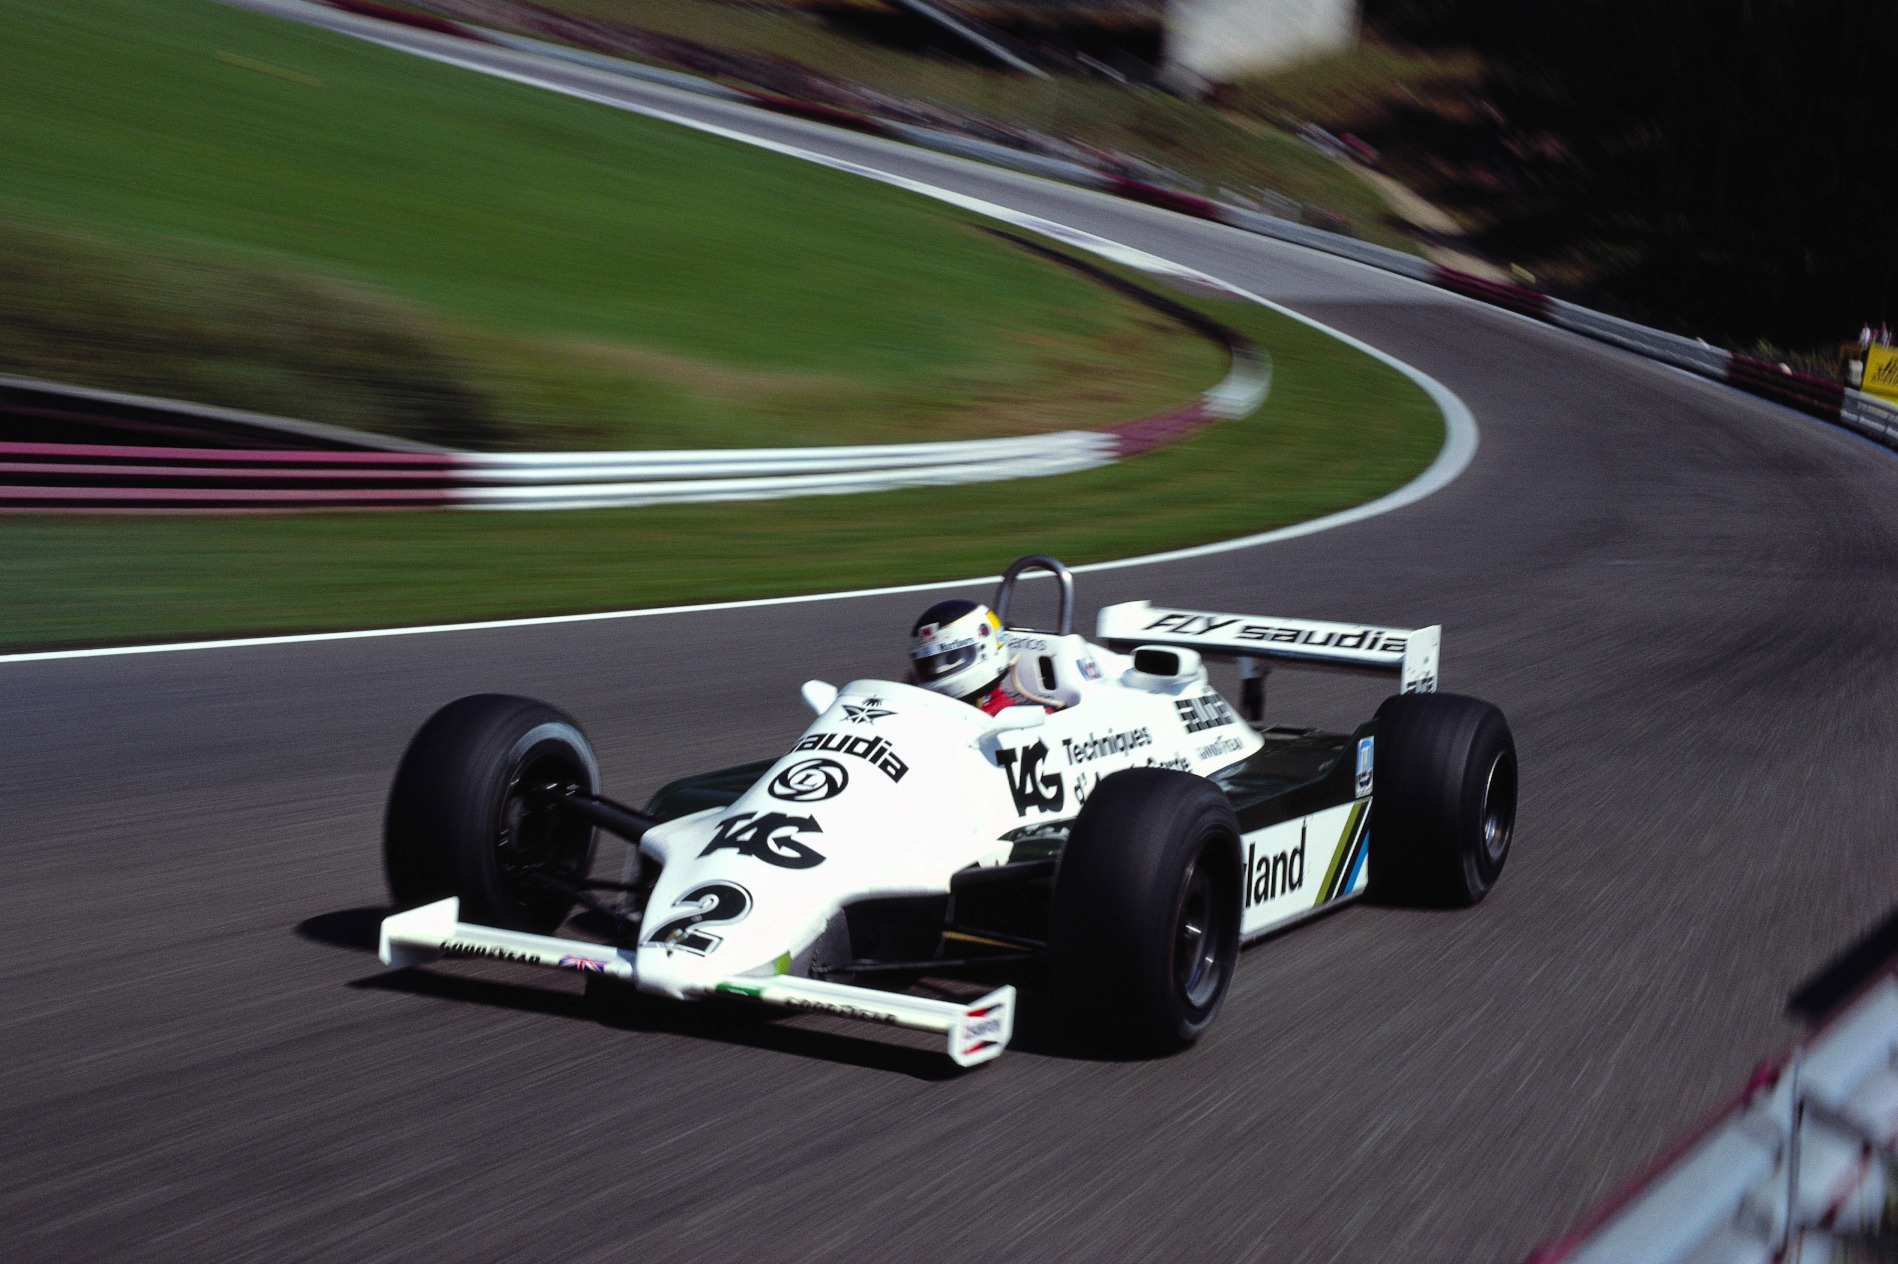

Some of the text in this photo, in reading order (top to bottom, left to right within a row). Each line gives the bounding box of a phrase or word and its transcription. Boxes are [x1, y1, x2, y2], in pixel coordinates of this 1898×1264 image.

[1144, 613, 1406, 653] FLY saudia
[1062, 727, 1152, 766] Techniques
[1242, 825, 1307, 909] land
[639, 879, 754, 957] 2
